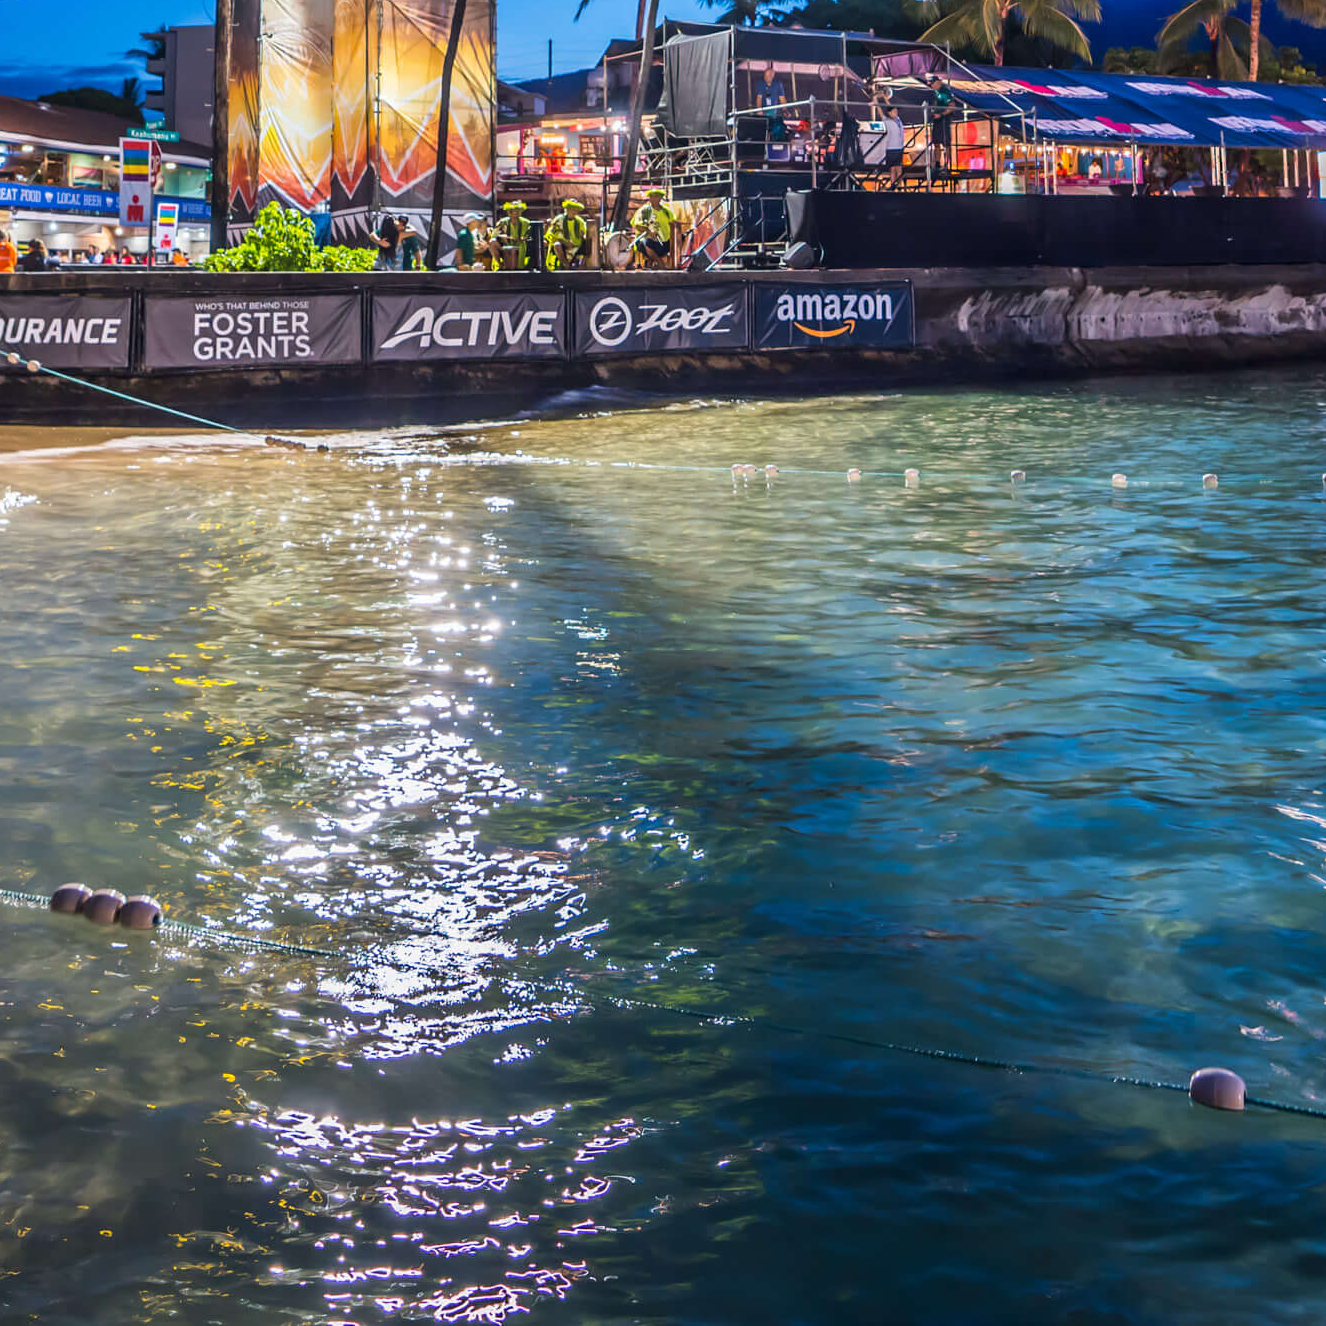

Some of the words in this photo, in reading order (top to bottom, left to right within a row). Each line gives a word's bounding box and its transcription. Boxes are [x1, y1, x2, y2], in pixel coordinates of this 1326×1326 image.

[20, 189, 42, 203] FOOD
[56, 192, 81, 206] LOCAL
[83, 194, 103, 207] BEER
[195, 302, 224, 310] WHO'S
[226, 302, 247, 310] THAT
[249, 301, 280, 310] BEHIND
[283, 301, 309, 309] THOSE
[777, 293, 892, 321] amazon
[194, 311, 310, 336] FOSTER
[380, 307, 558, 348] ACTIVE
